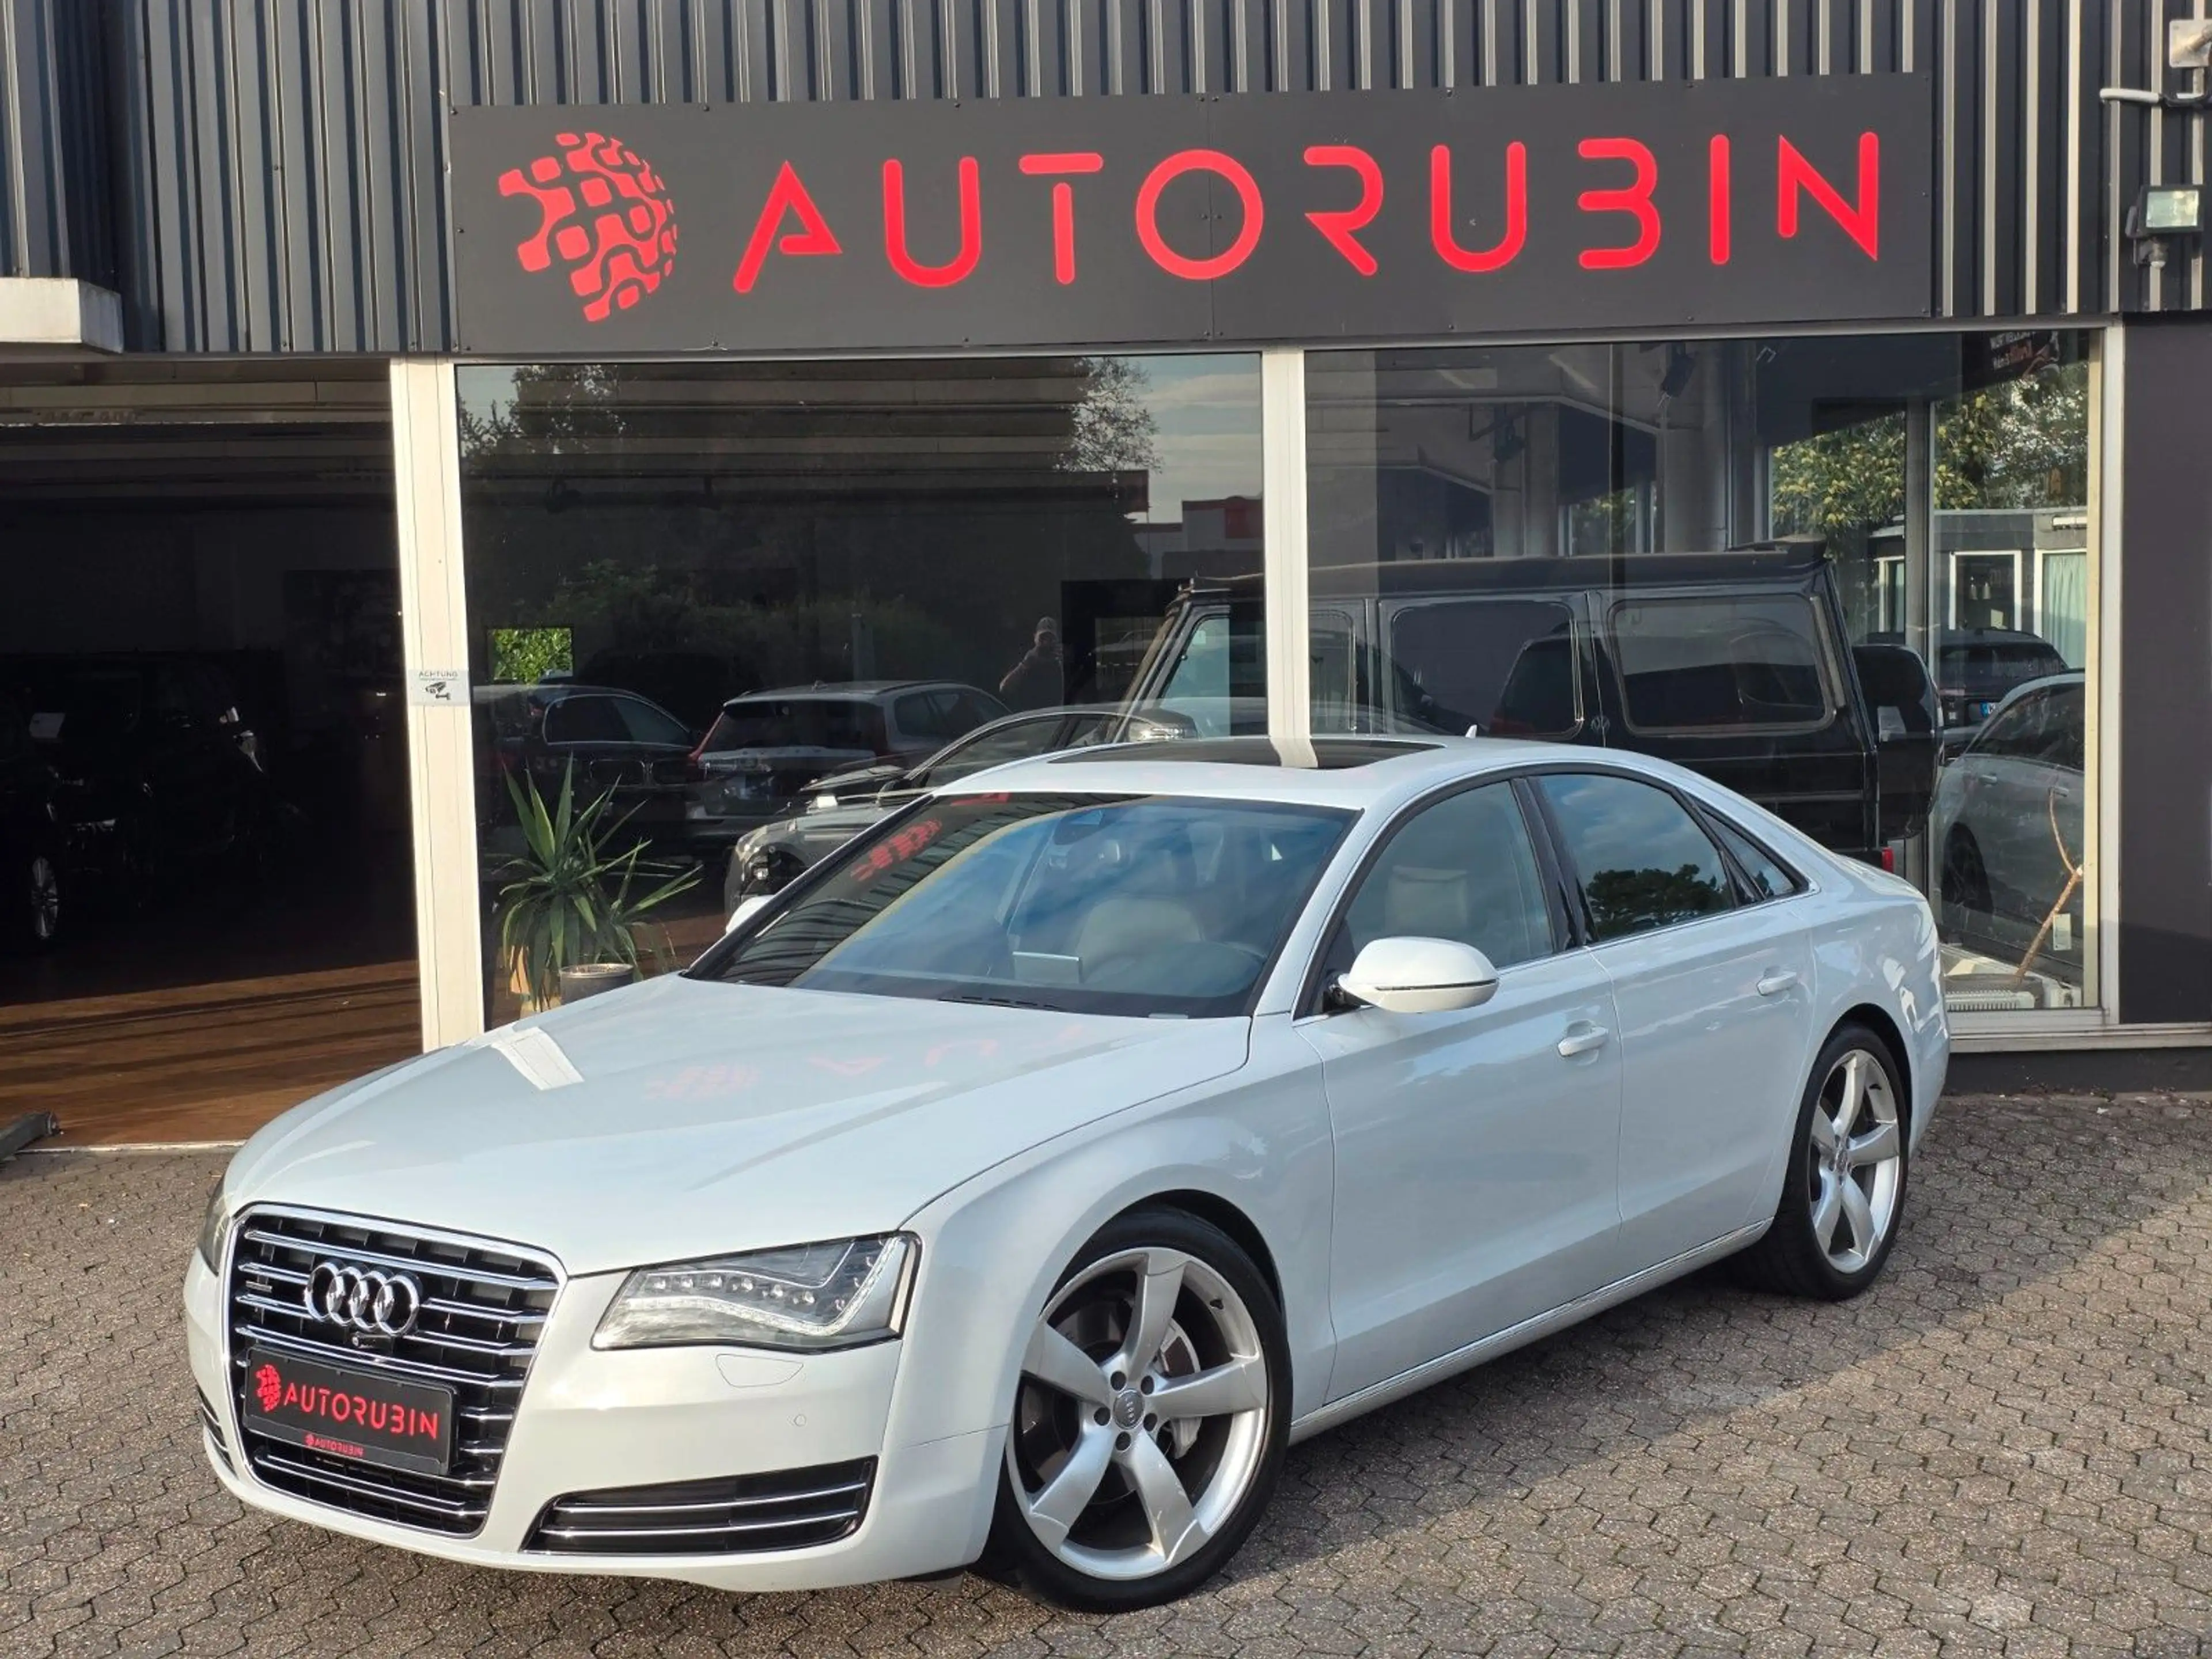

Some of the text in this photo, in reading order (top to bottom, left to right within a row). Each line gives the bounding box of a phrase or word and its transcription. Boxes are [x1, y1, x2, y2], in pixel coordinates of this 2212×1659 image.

[732, 131, 1881, 296] AUTORUBIN
[283, 1382, 438, 1440] AUTORUBIN
[314, 1440, 365, 1457] AUTORUBIN
